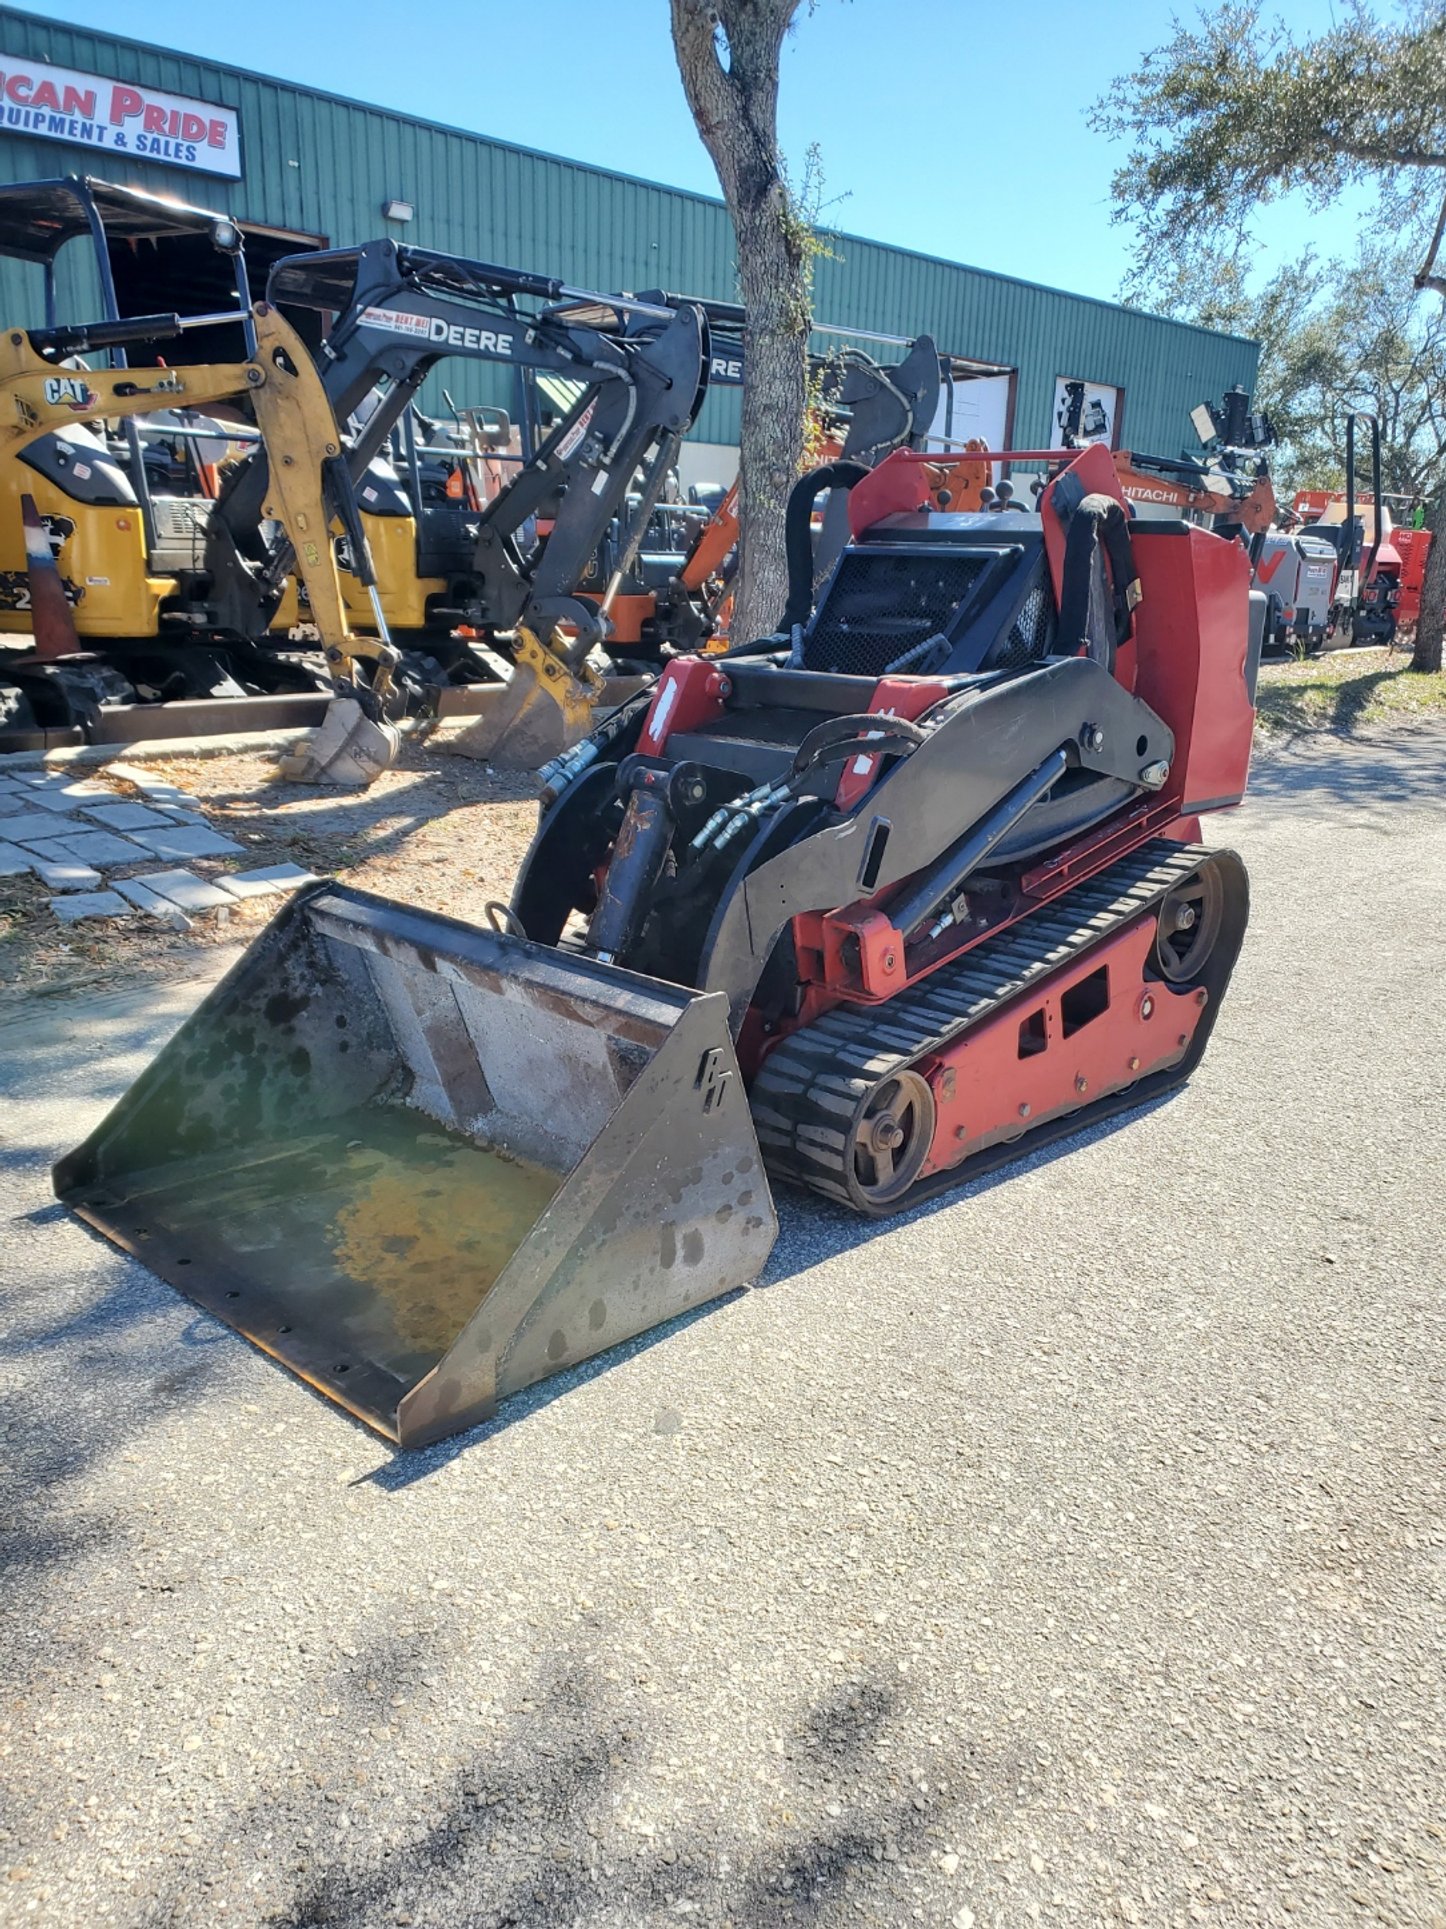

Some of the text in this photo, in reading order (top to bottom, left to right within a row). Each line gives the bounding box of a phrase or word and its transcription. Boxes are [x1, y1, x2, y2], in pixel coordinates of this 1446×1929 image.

[110, 84, 228, 149] PRIDE
[114, 131, 128, 148] &
[136, 133, 197, 163] SALES
[430, 317, 513, 355] DEERE
[44, 378, 86, 405] CAT
[1121, 486, 1178, 503] HITACHI
